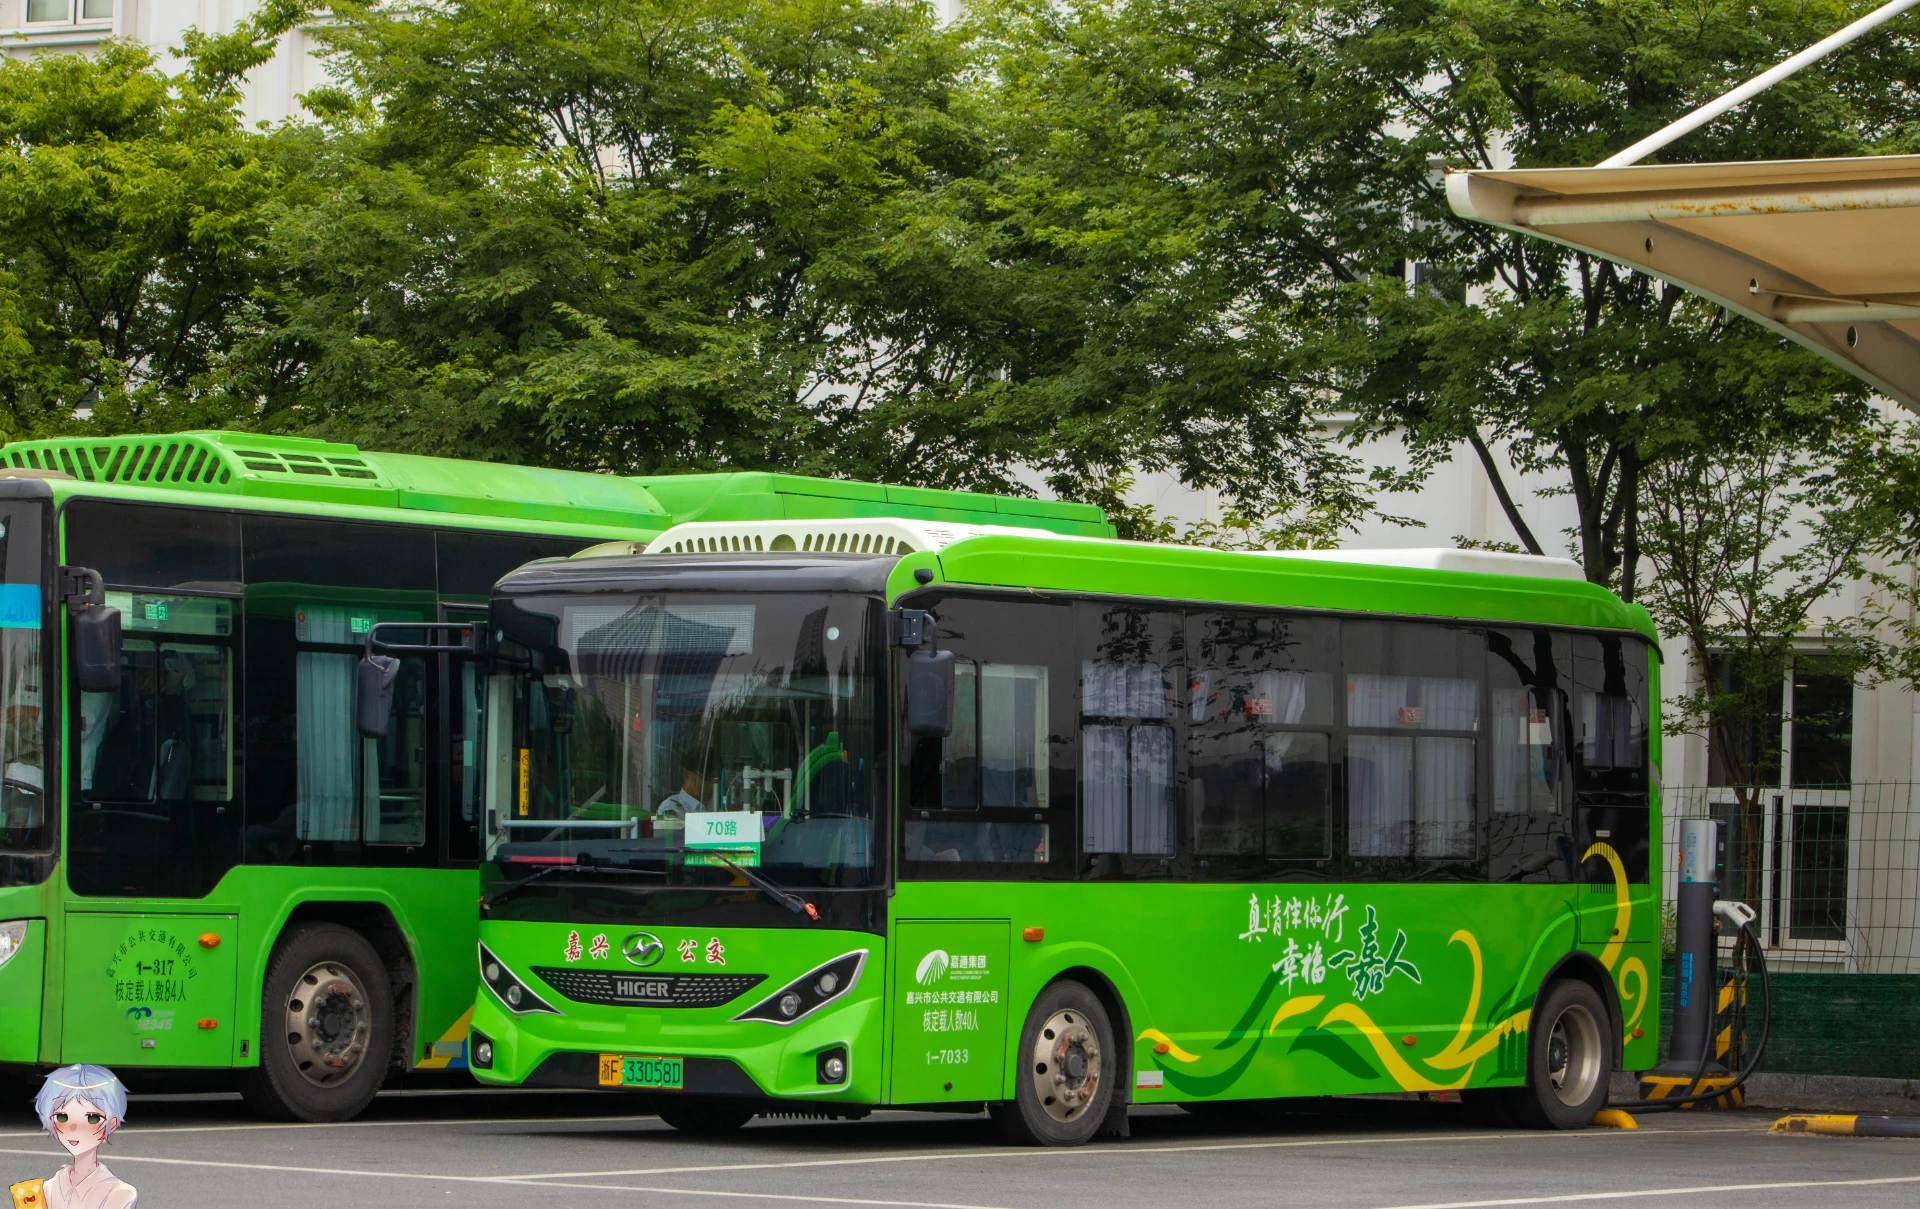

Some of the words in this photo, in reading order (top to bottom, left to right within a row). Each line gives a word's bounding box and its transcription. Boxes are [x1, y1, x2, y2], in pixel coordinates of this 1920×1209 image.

[706, 821, 737, 836] 70路
[1239, 893, 1349, 943] 真情伴你行
[106, 928, 198, 979] 嘉兴市公共交通有限公司
[1272, 904, 1422, 1002] 幸福一嘉人
[136, 959, 175, 975] 1-317
[950, 955, 987, 969] 嘉通集团
[115, 979, 186, 1002] 核定载人数84人
[617, 981, 669, 997] HIGER
[906, 991, 998, 1004] 嘉兴市公共交通有限公司
[923, 1009, 979, 1032] 核定载人数40人
[926, 1049, 969, 1065] 1-7033
